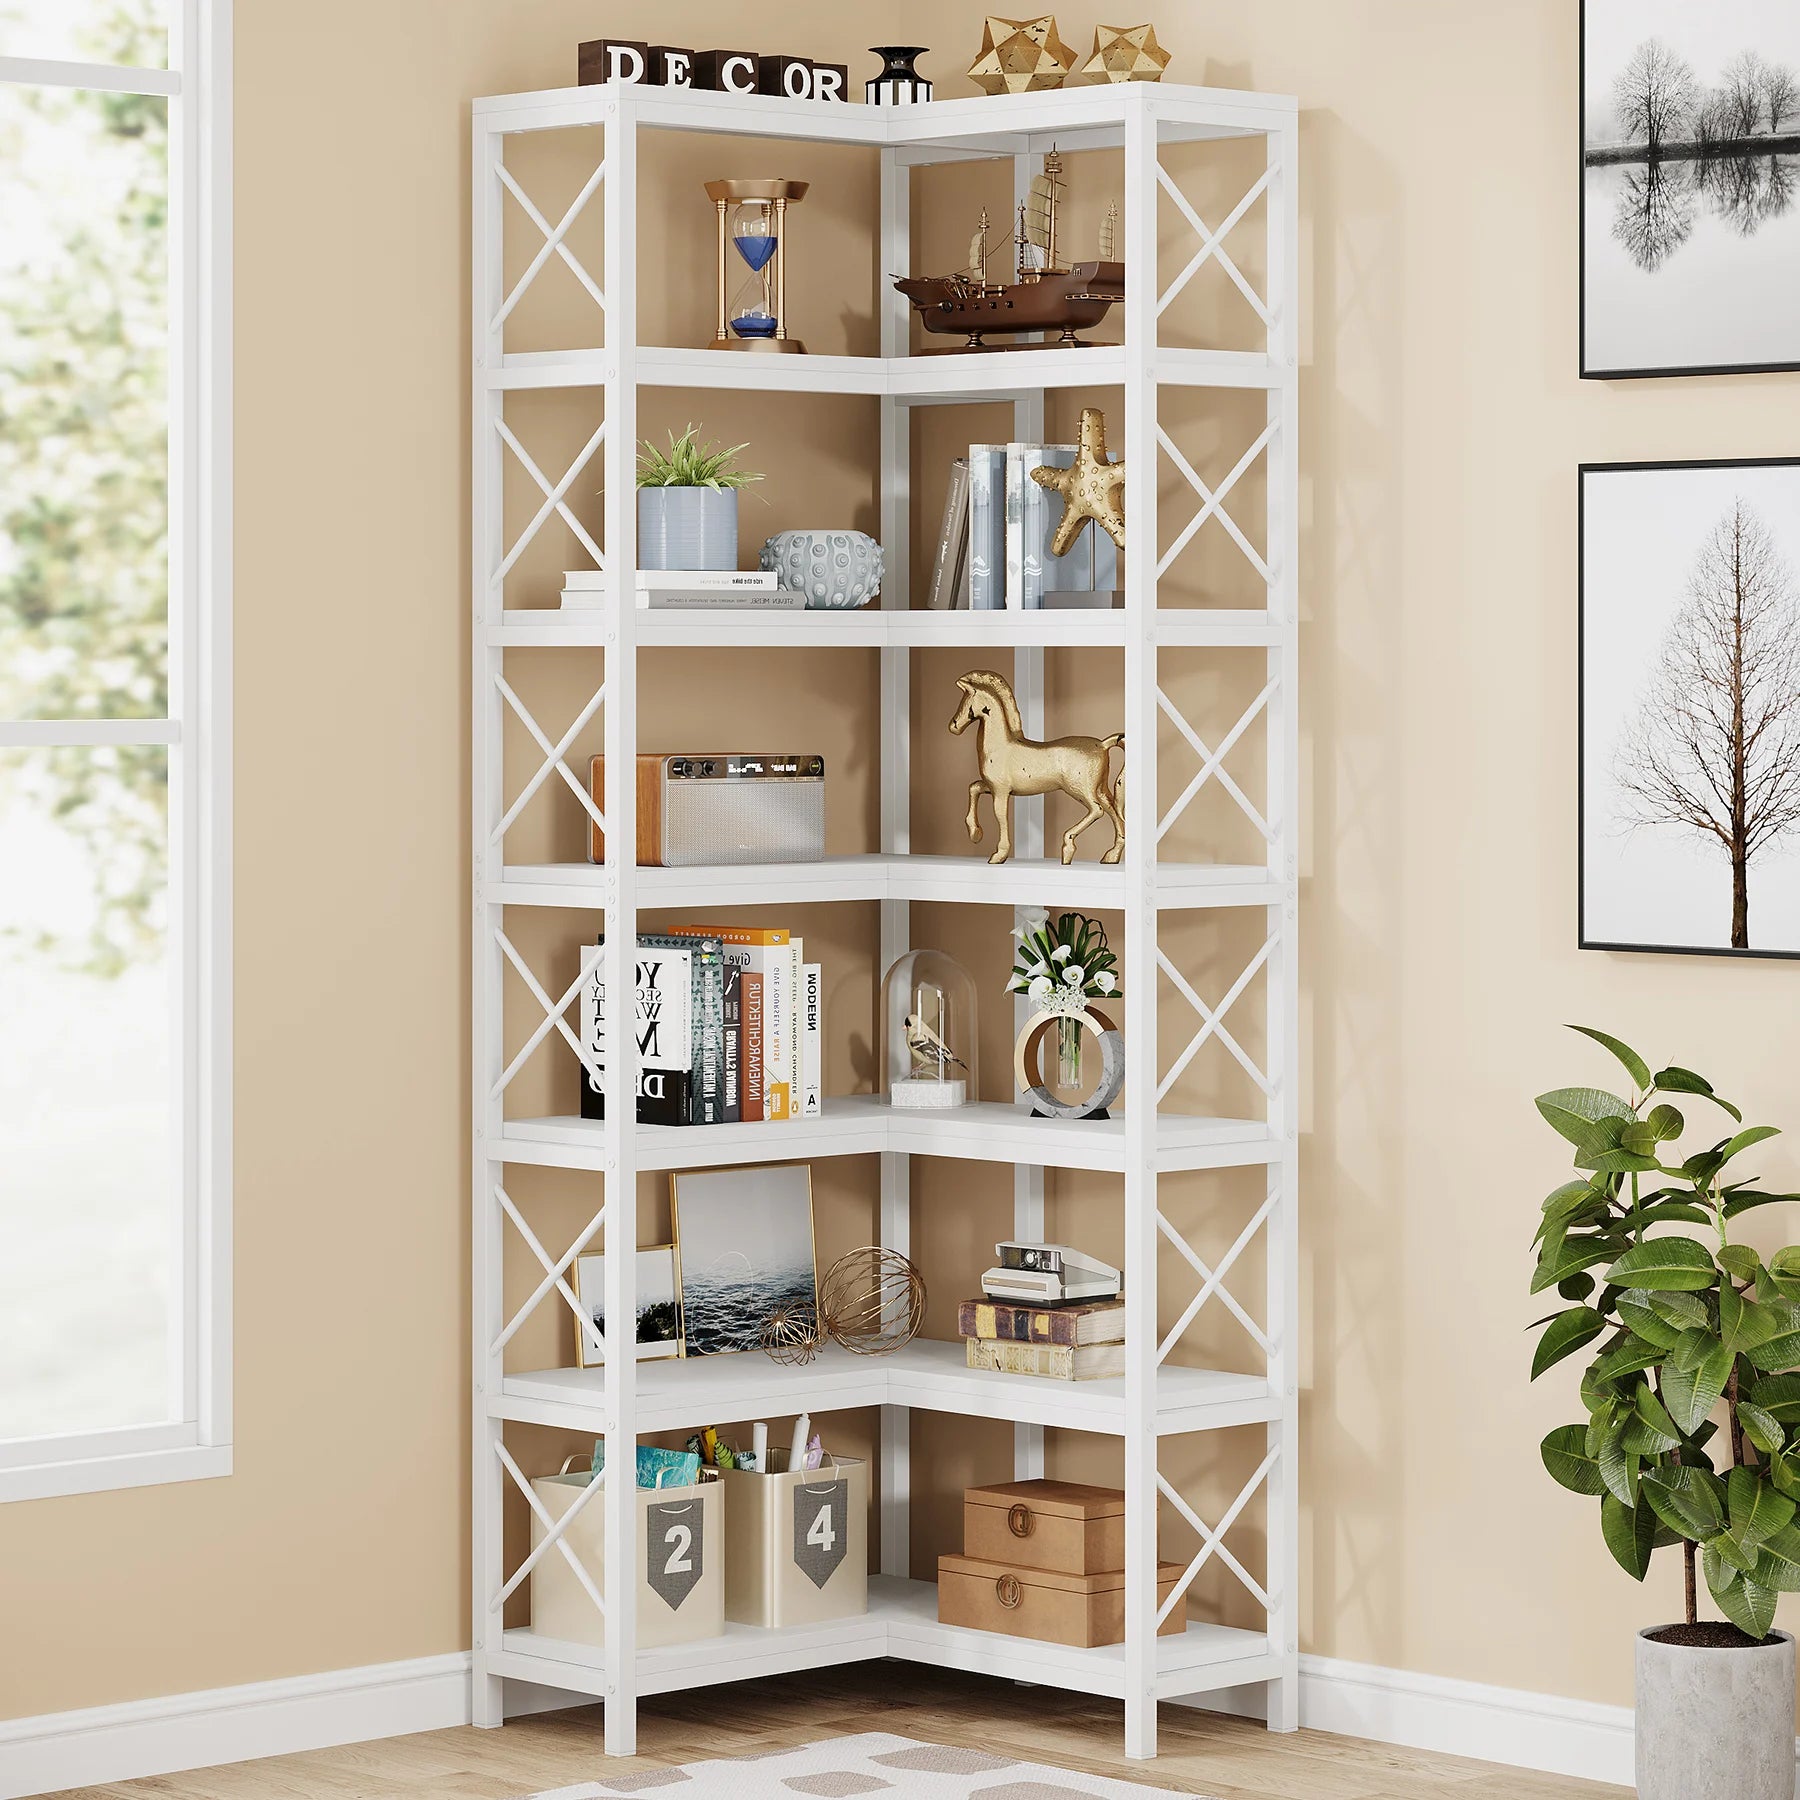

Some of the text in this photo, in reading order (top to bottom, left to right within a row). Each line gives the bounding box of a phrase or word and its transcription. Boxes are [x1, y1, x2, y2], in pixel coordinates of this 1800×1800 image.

[606, 45, 846, 103] DECOR
[664, 1524, 693, 1575] 2
[806, 1504, 836, 1552] 4
